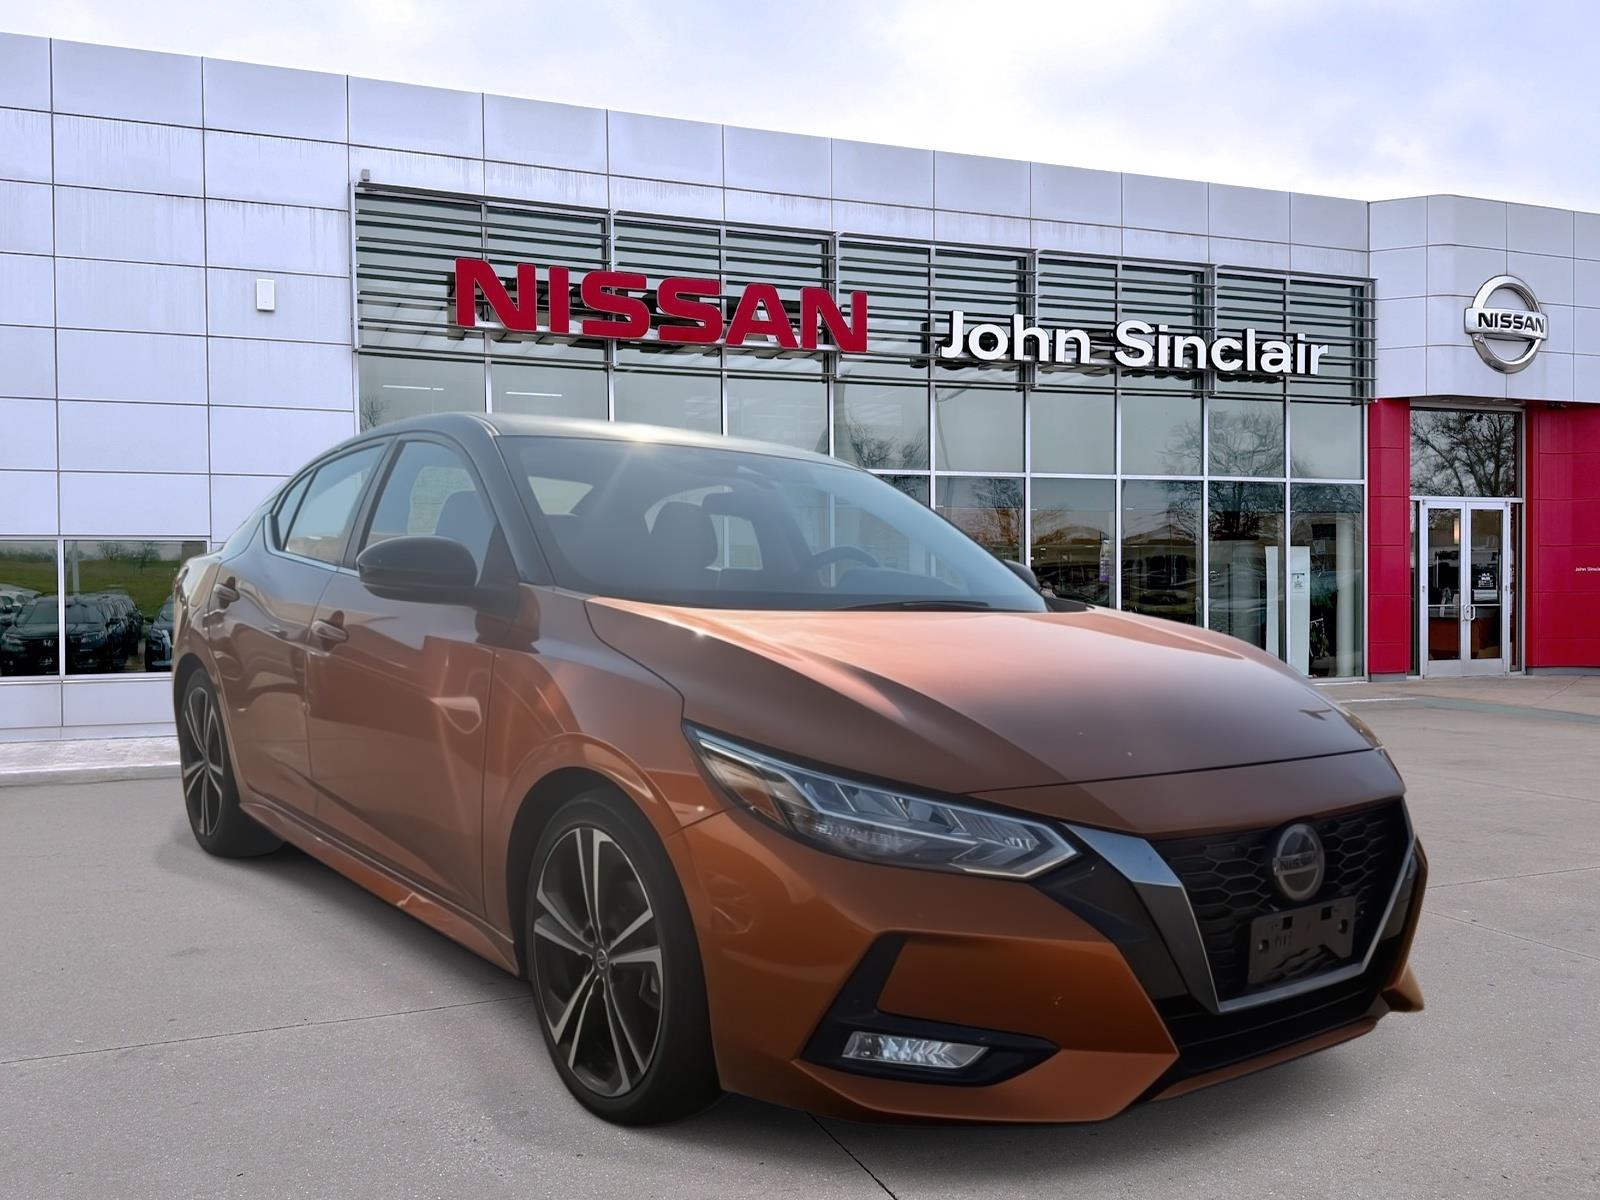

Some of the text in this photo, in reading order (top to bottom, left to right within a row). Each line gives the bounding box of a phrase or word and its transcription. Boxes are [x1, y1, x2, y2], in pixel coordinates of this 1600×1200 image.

[455, 257, 868, 353] NISSAN
[1478, 312, 1545, 334] NISSAN
[940, 309, 1330, 375] John Sinclair
[1279, 851, 1314, 871] NIS
